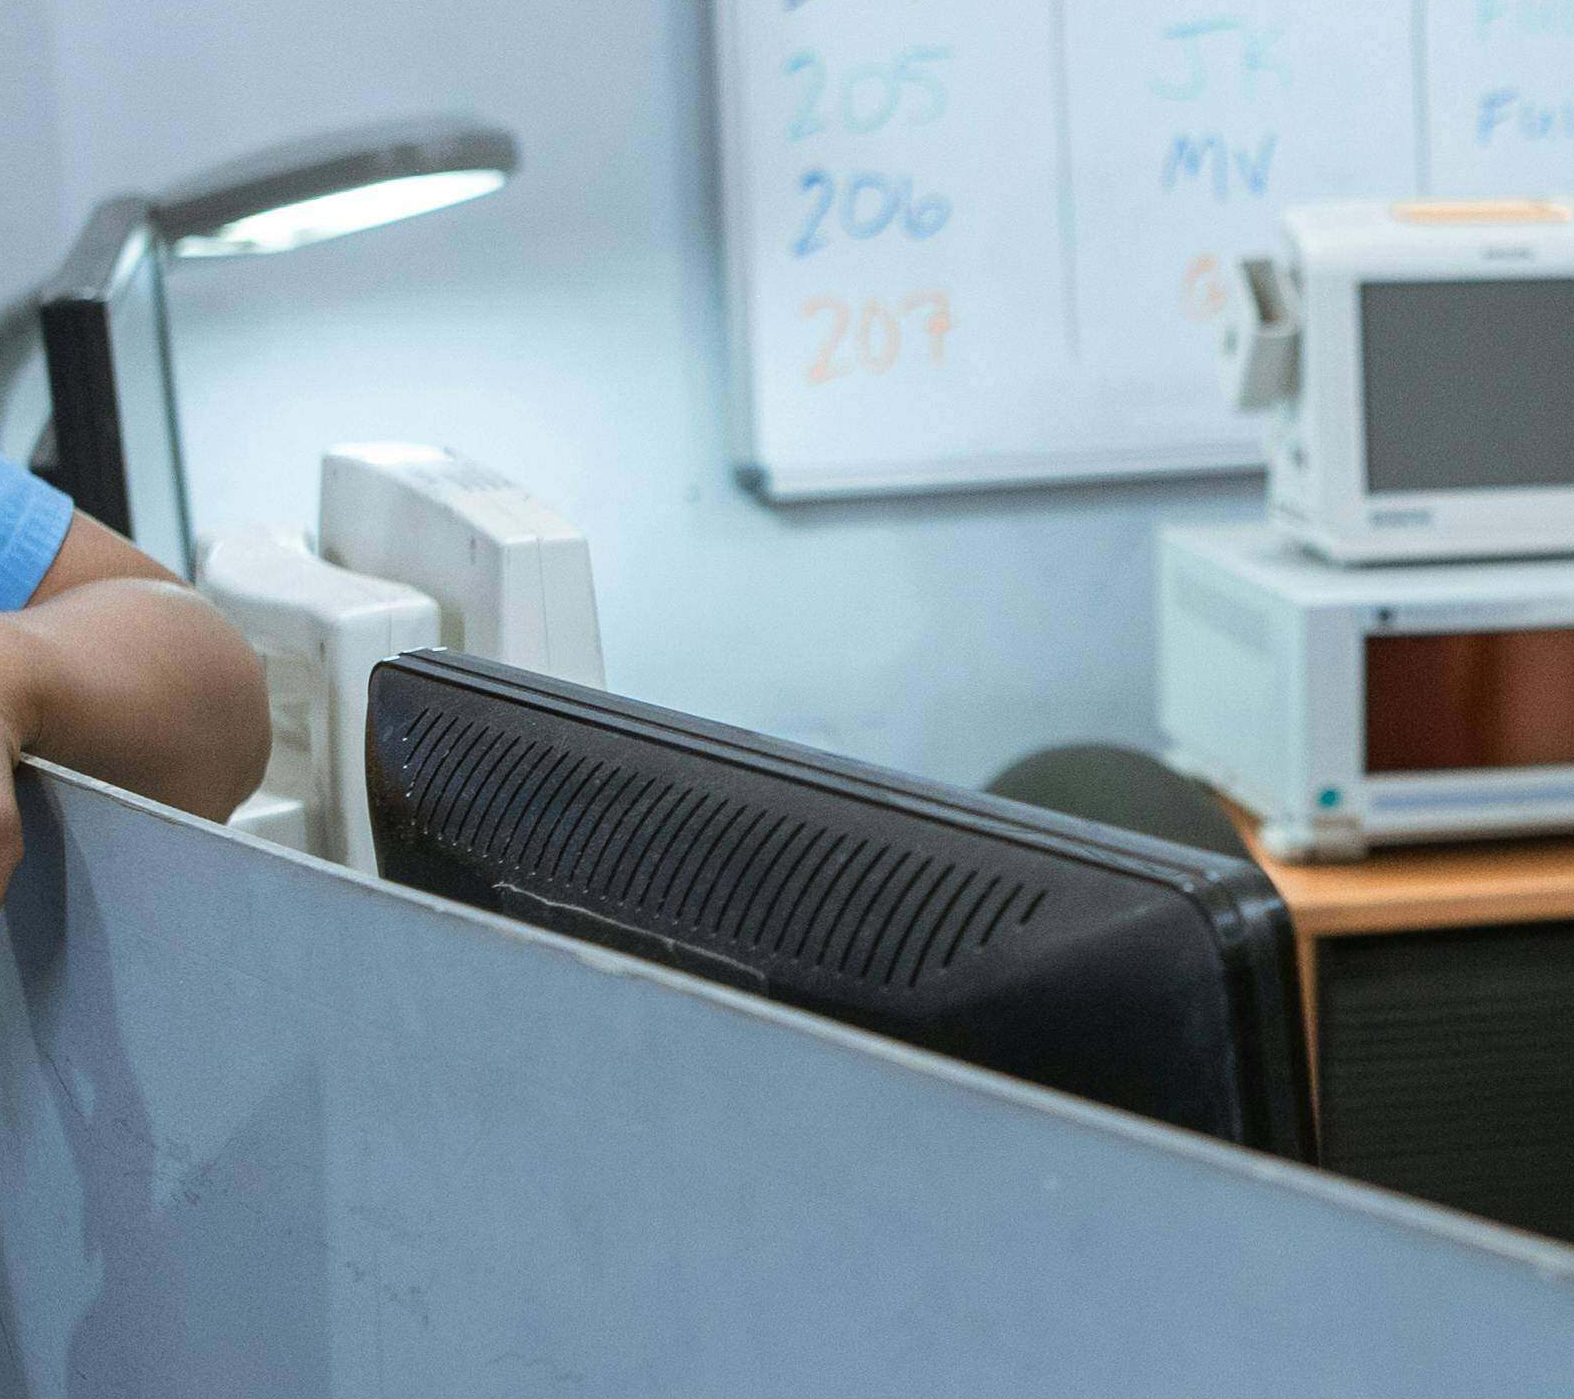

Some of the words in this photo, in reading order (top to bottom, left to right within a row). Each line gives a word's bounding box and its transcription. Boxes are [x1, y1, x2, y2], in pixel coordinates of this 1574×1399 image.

[781, 42, 956, 144] 205
[1143, 14, 1292, 103] JK
[791, 165, 952, 260] 206
[1161, 131, 1279, 201] MV
[800, 288, 957, 386] 207
